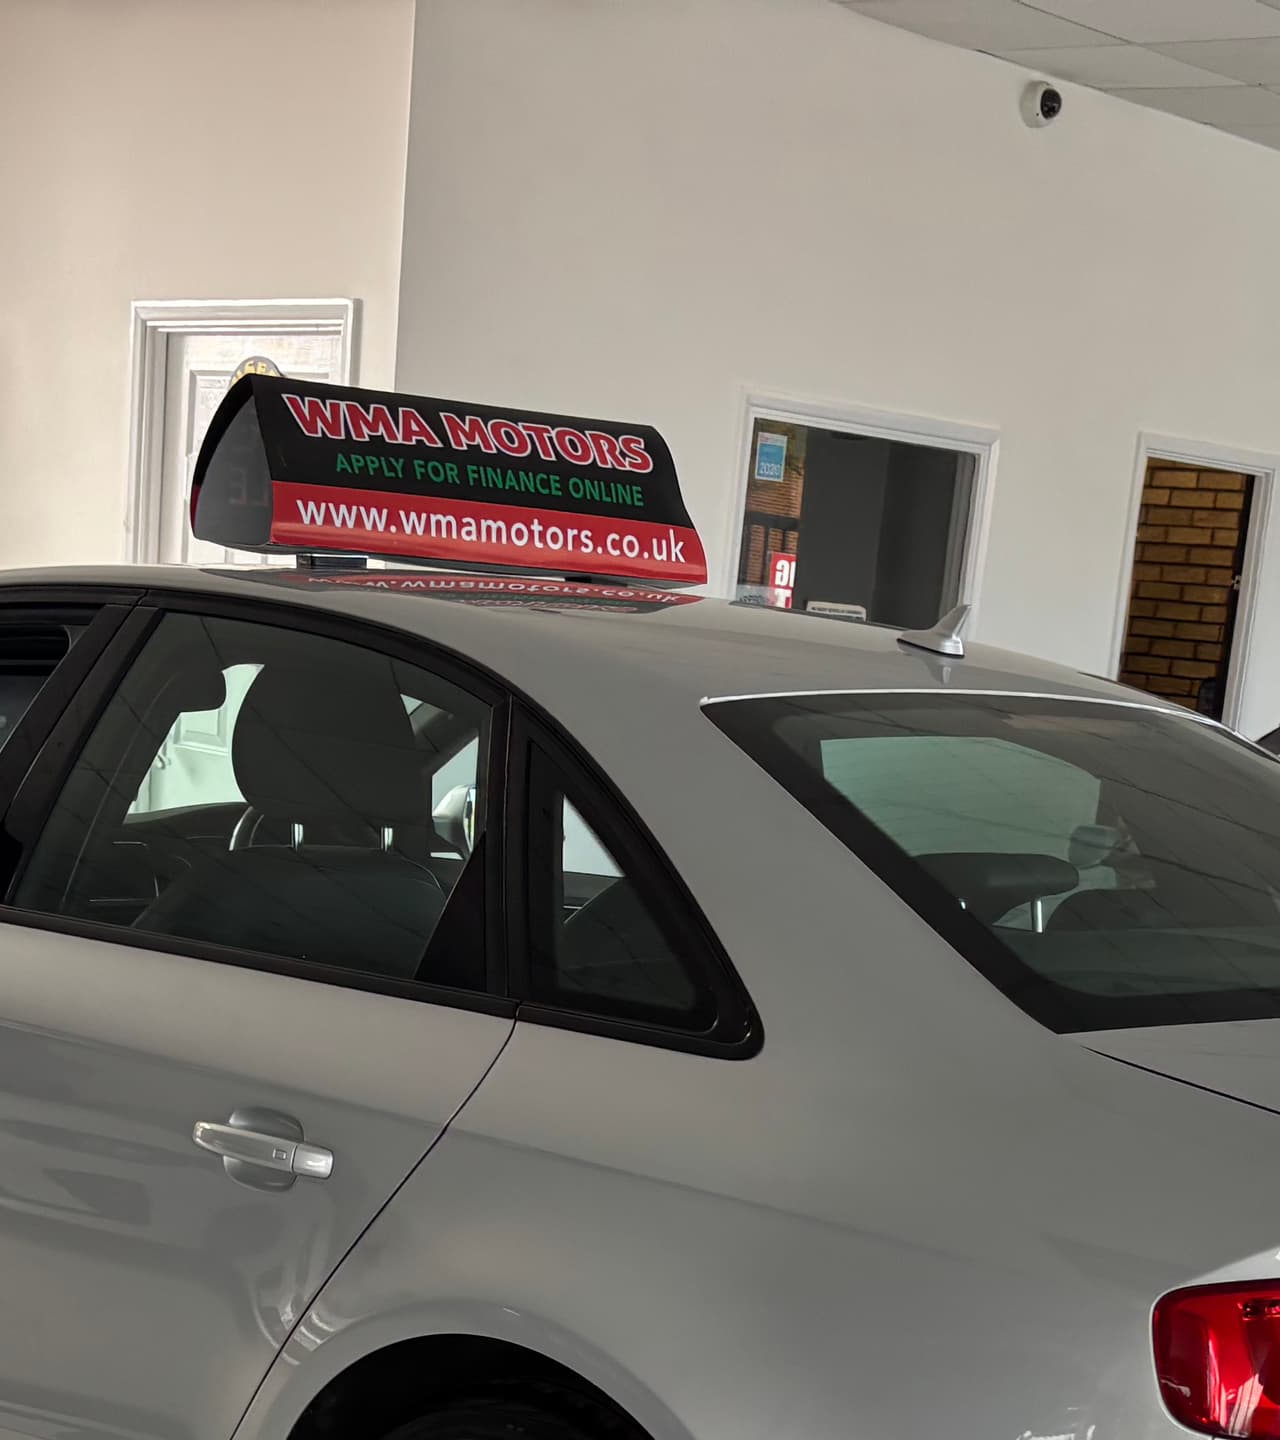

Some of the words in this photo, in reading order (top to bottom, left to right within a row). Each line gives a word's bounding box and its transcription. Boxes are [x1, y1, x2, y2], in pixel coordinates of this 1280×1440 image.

[281, 393, 443, 447] WMA
[440, 412, 653, 473] MOTORS
[335, 453, 405, 479] APPLY
[413, 460, 461, 485] FOR
[466, 465, 563, 497] FINANCE
[569, 477, 645, 507] ONLINE
[296, 499, 686, 563] www.wmamotors.co.uk
